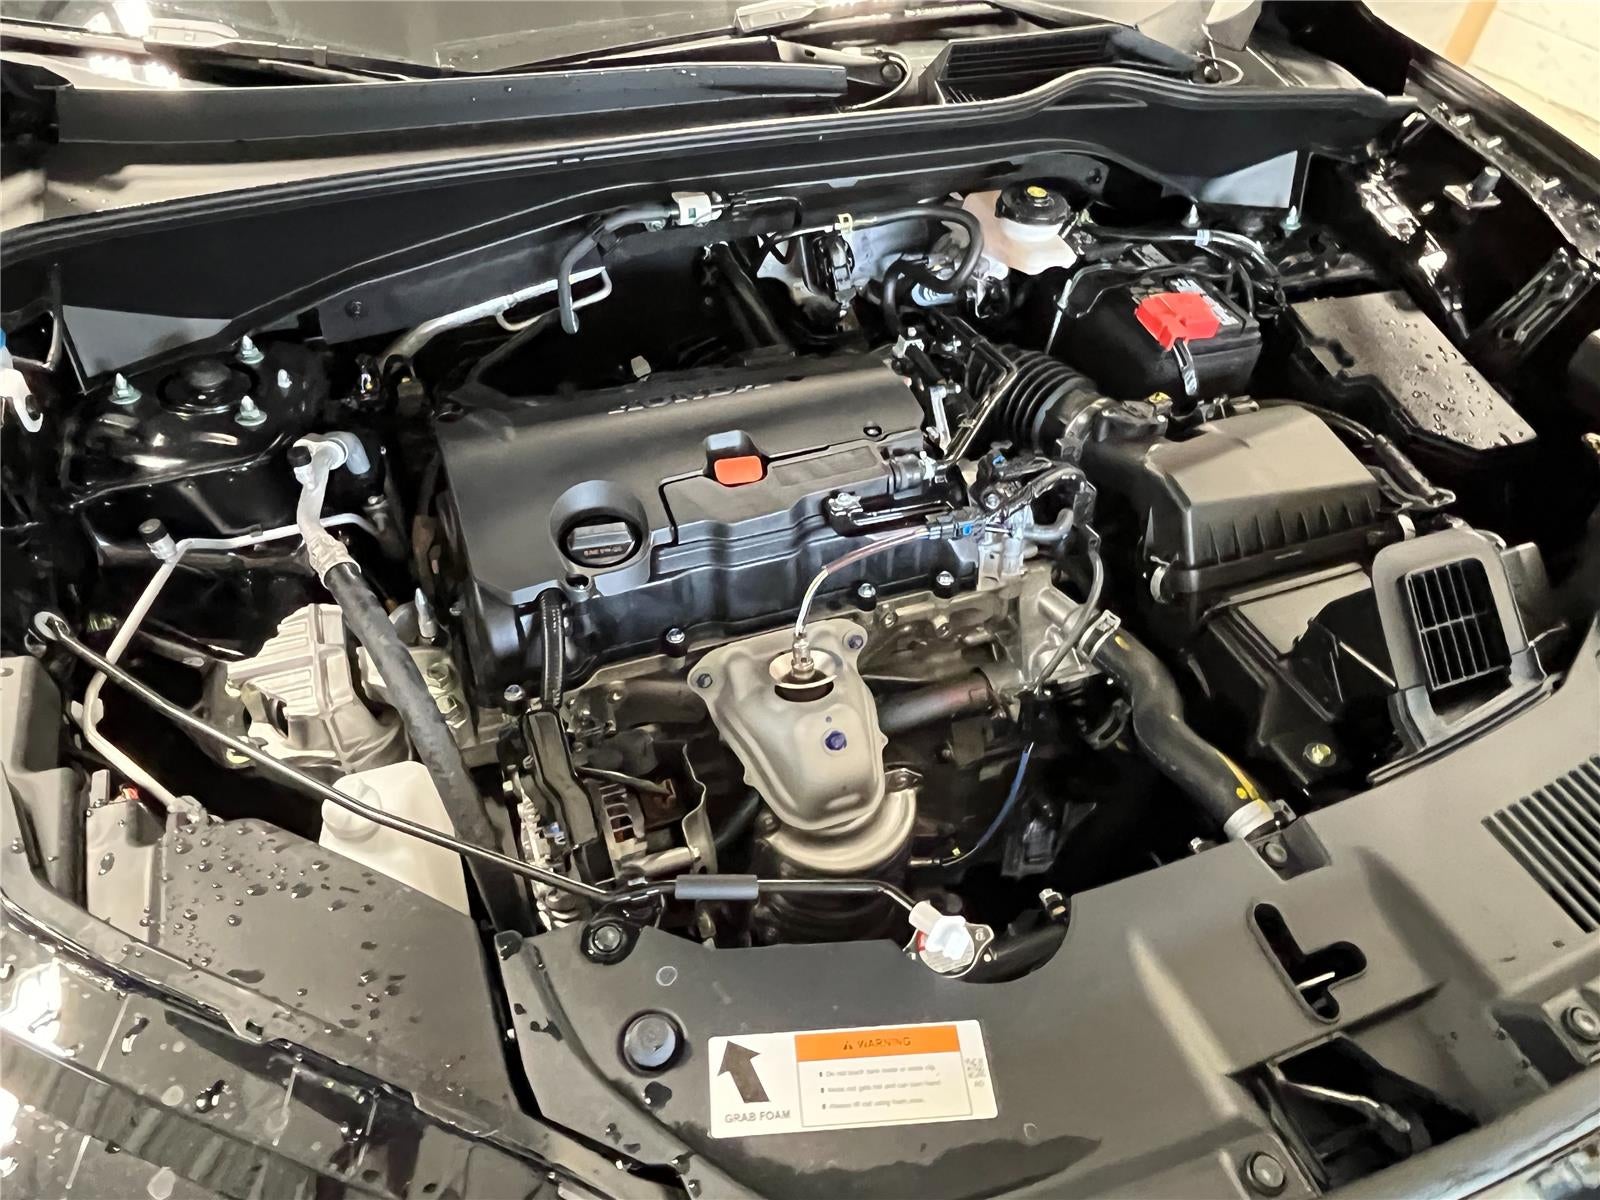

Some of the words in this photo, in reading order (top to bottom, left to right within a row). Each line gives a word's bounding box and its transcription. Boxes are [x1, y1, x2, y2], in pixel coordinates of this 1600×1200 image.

[857, 1036, 912, 1049] WARNING
[724, 1111, 757, 1123] GRAB
[759, 1109, 791, 1121] FOAM
